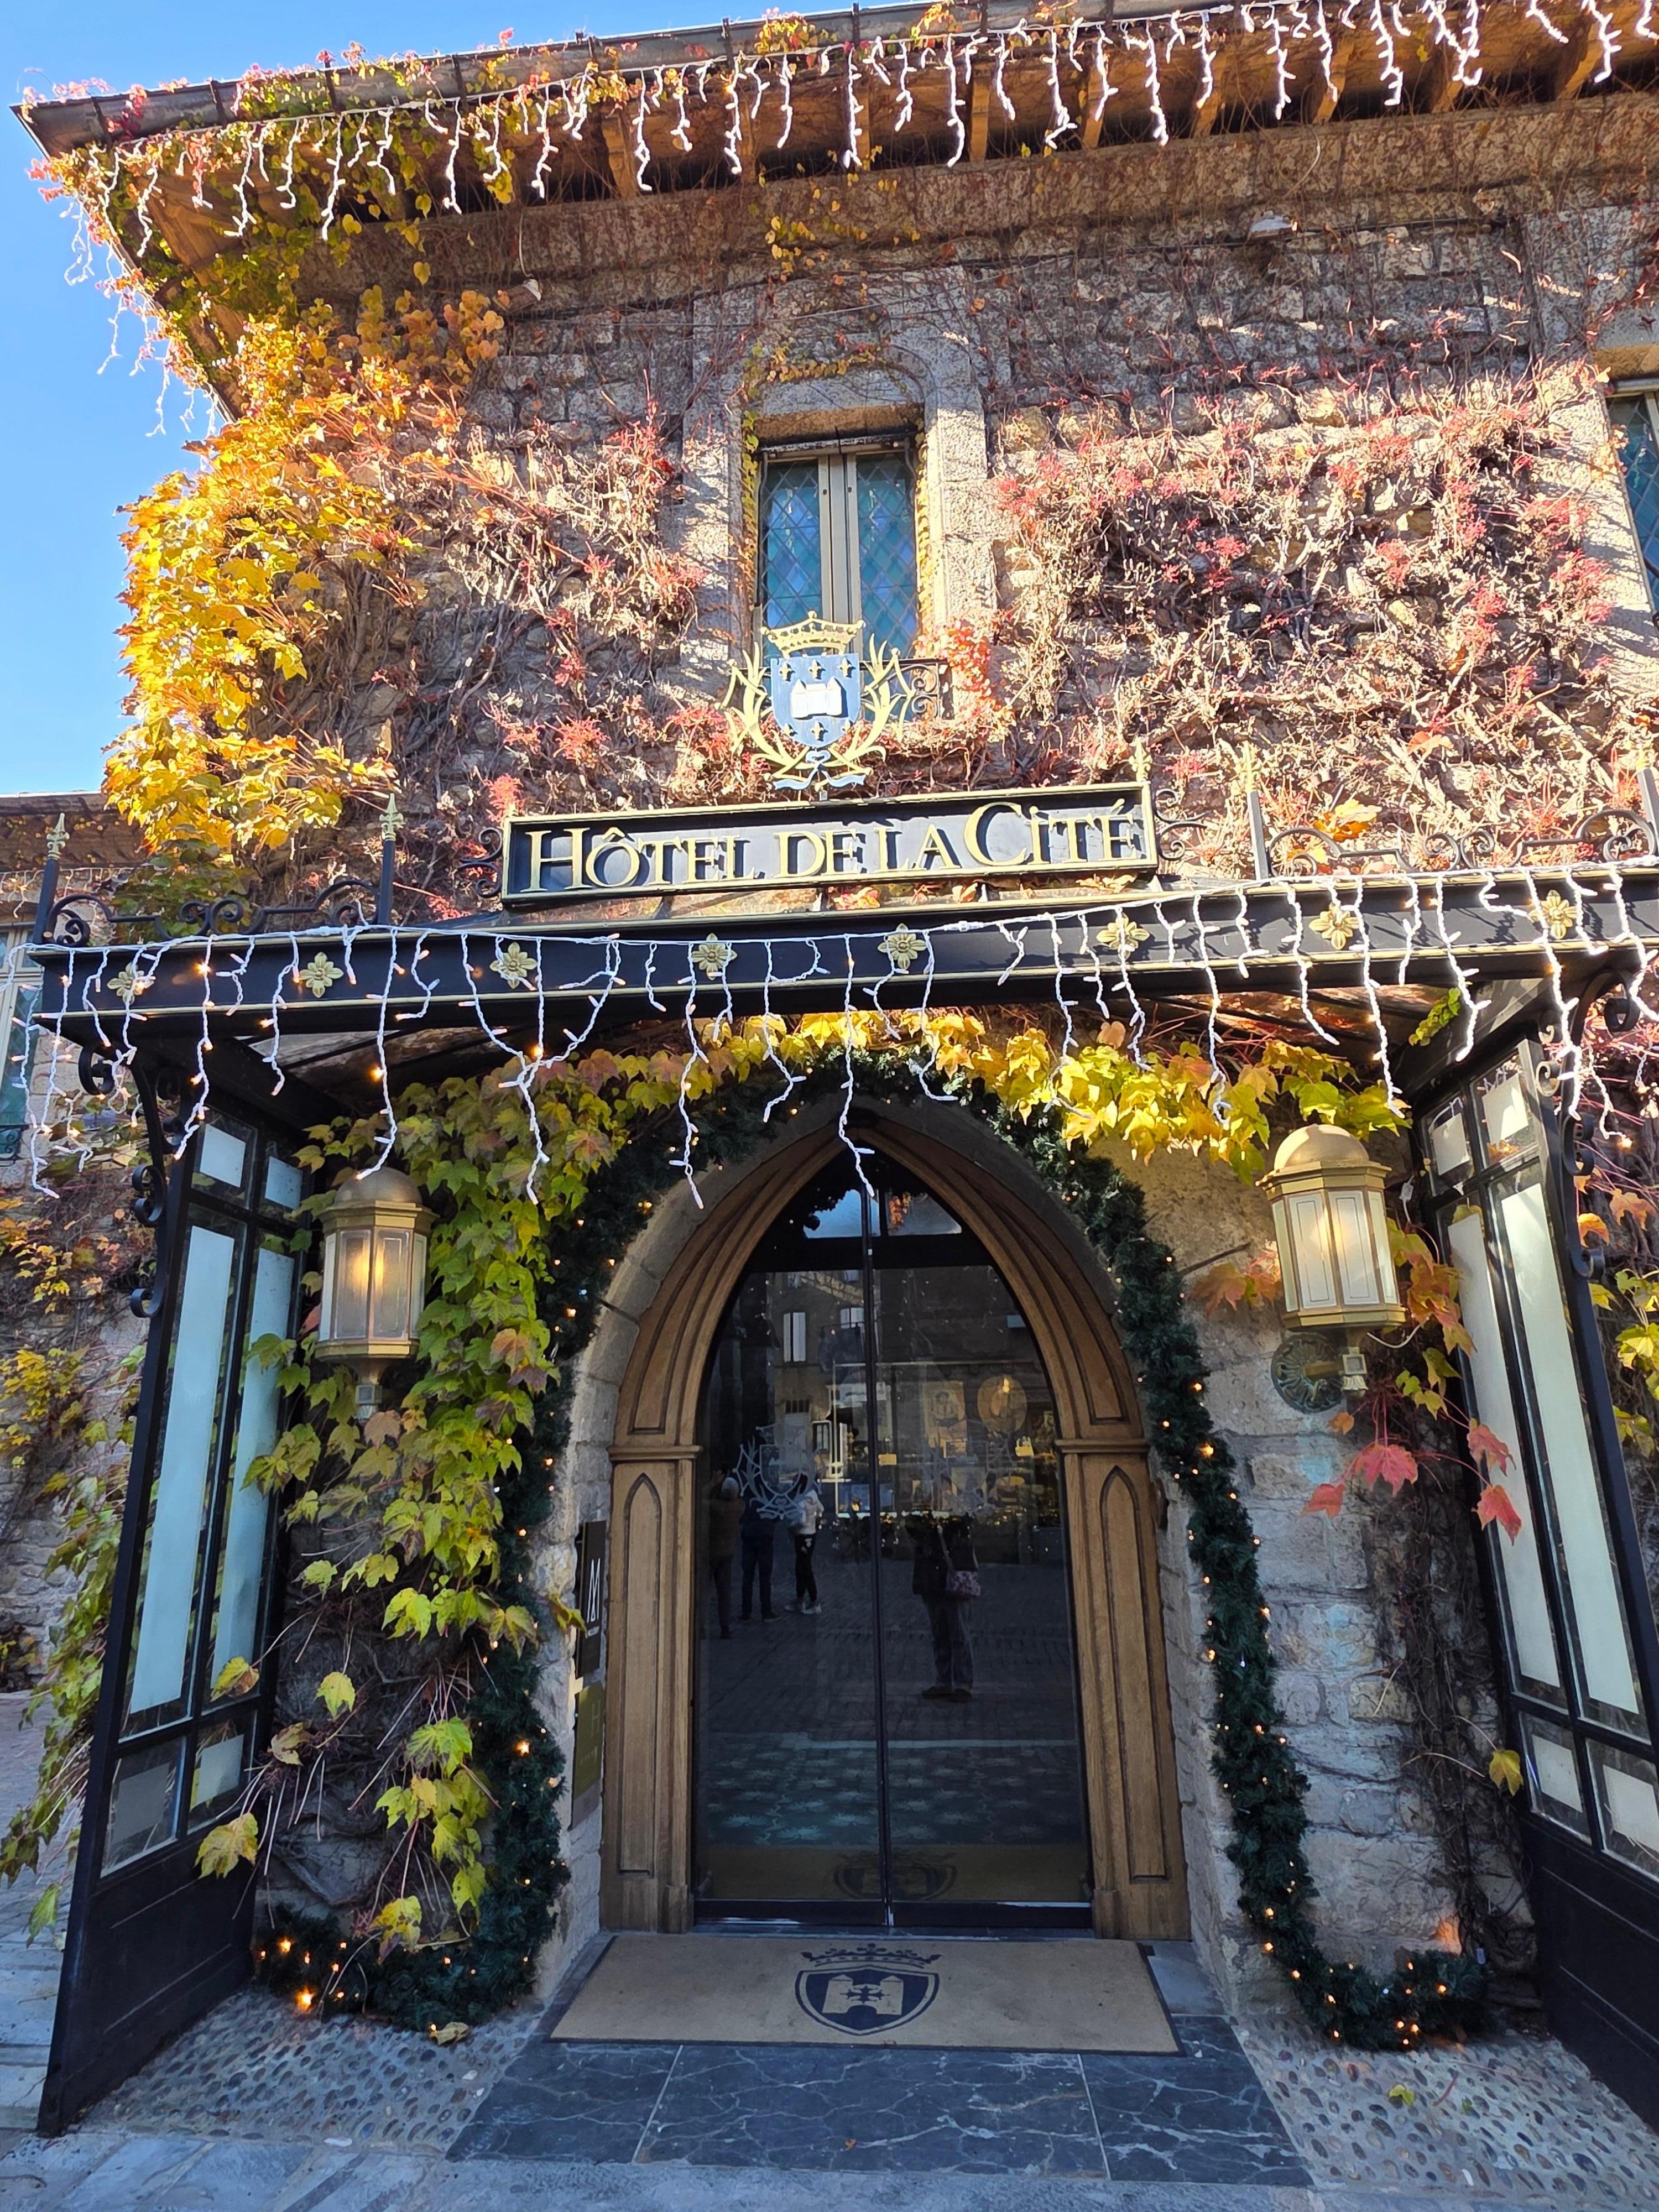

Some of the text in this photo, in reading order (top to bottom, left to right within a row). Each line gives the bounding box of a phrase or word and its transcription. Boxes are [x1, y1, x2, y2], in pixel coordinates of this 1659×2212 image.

[520, 827, 755, 892] HÔTEL
[771, 828, 857, 878] DE
[873, 825, 961, 873] LA
